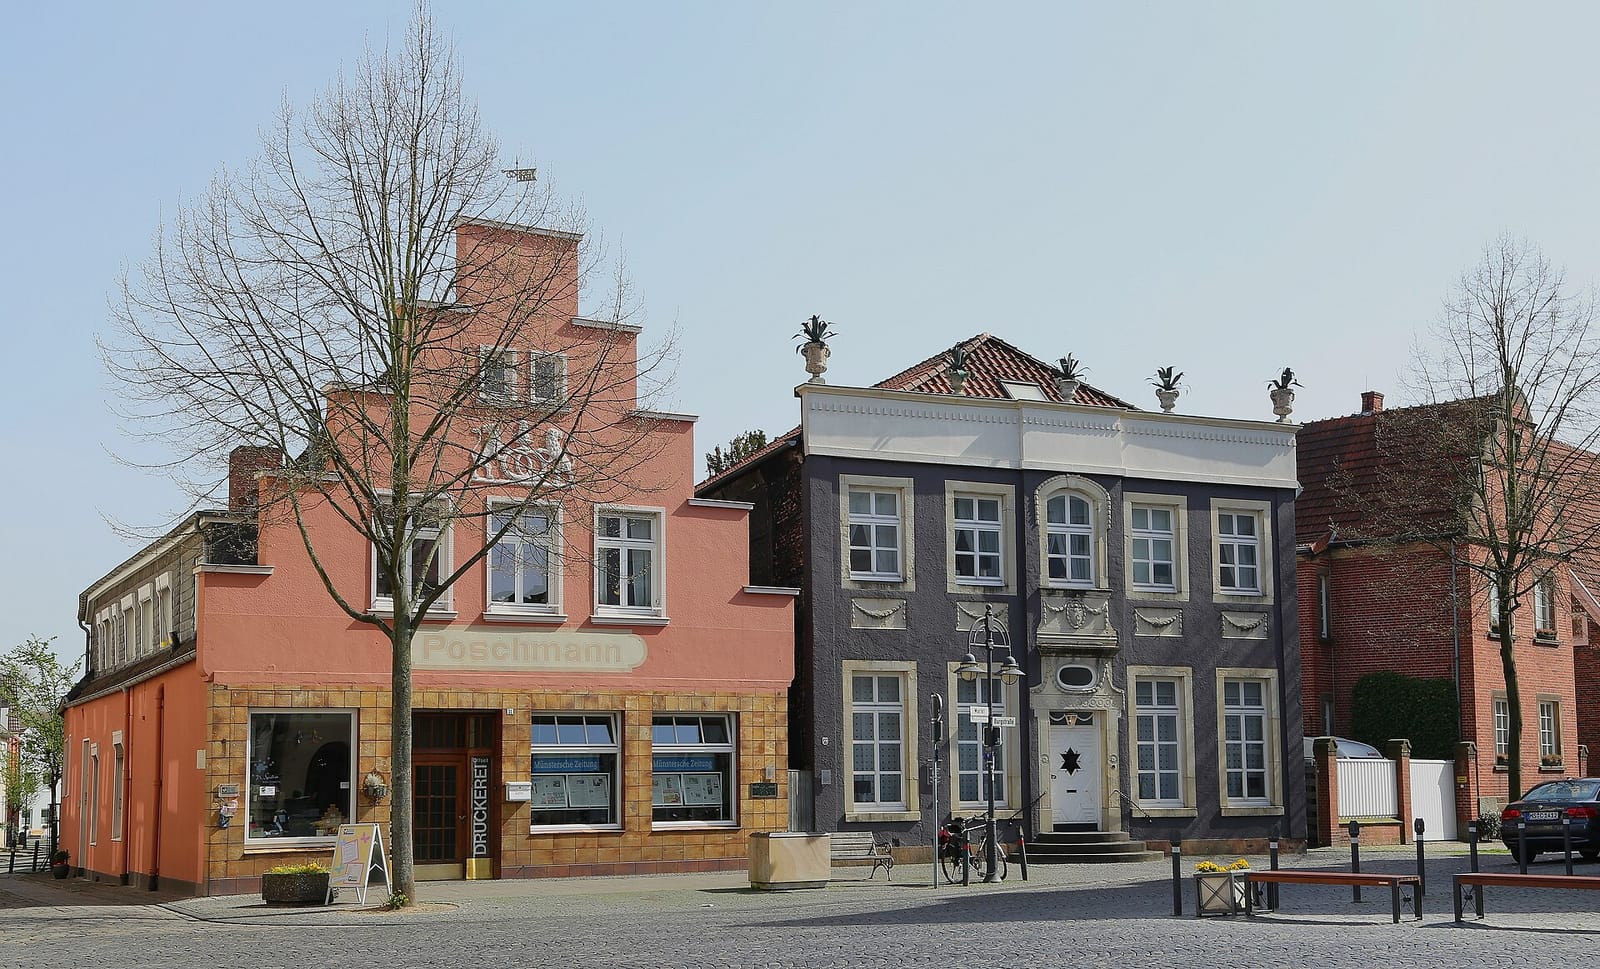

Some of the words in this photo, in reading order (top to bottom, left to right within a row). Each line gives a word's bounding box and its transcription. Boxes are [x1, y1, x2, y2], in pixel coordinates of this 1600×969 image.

[423, 634, 621, 663] Poschmann
[533, 759, 573, 769] Münstersche
[574, 760, 598, 770] Zeitung
[474, 764, 488, 856] DRUCKEREI
